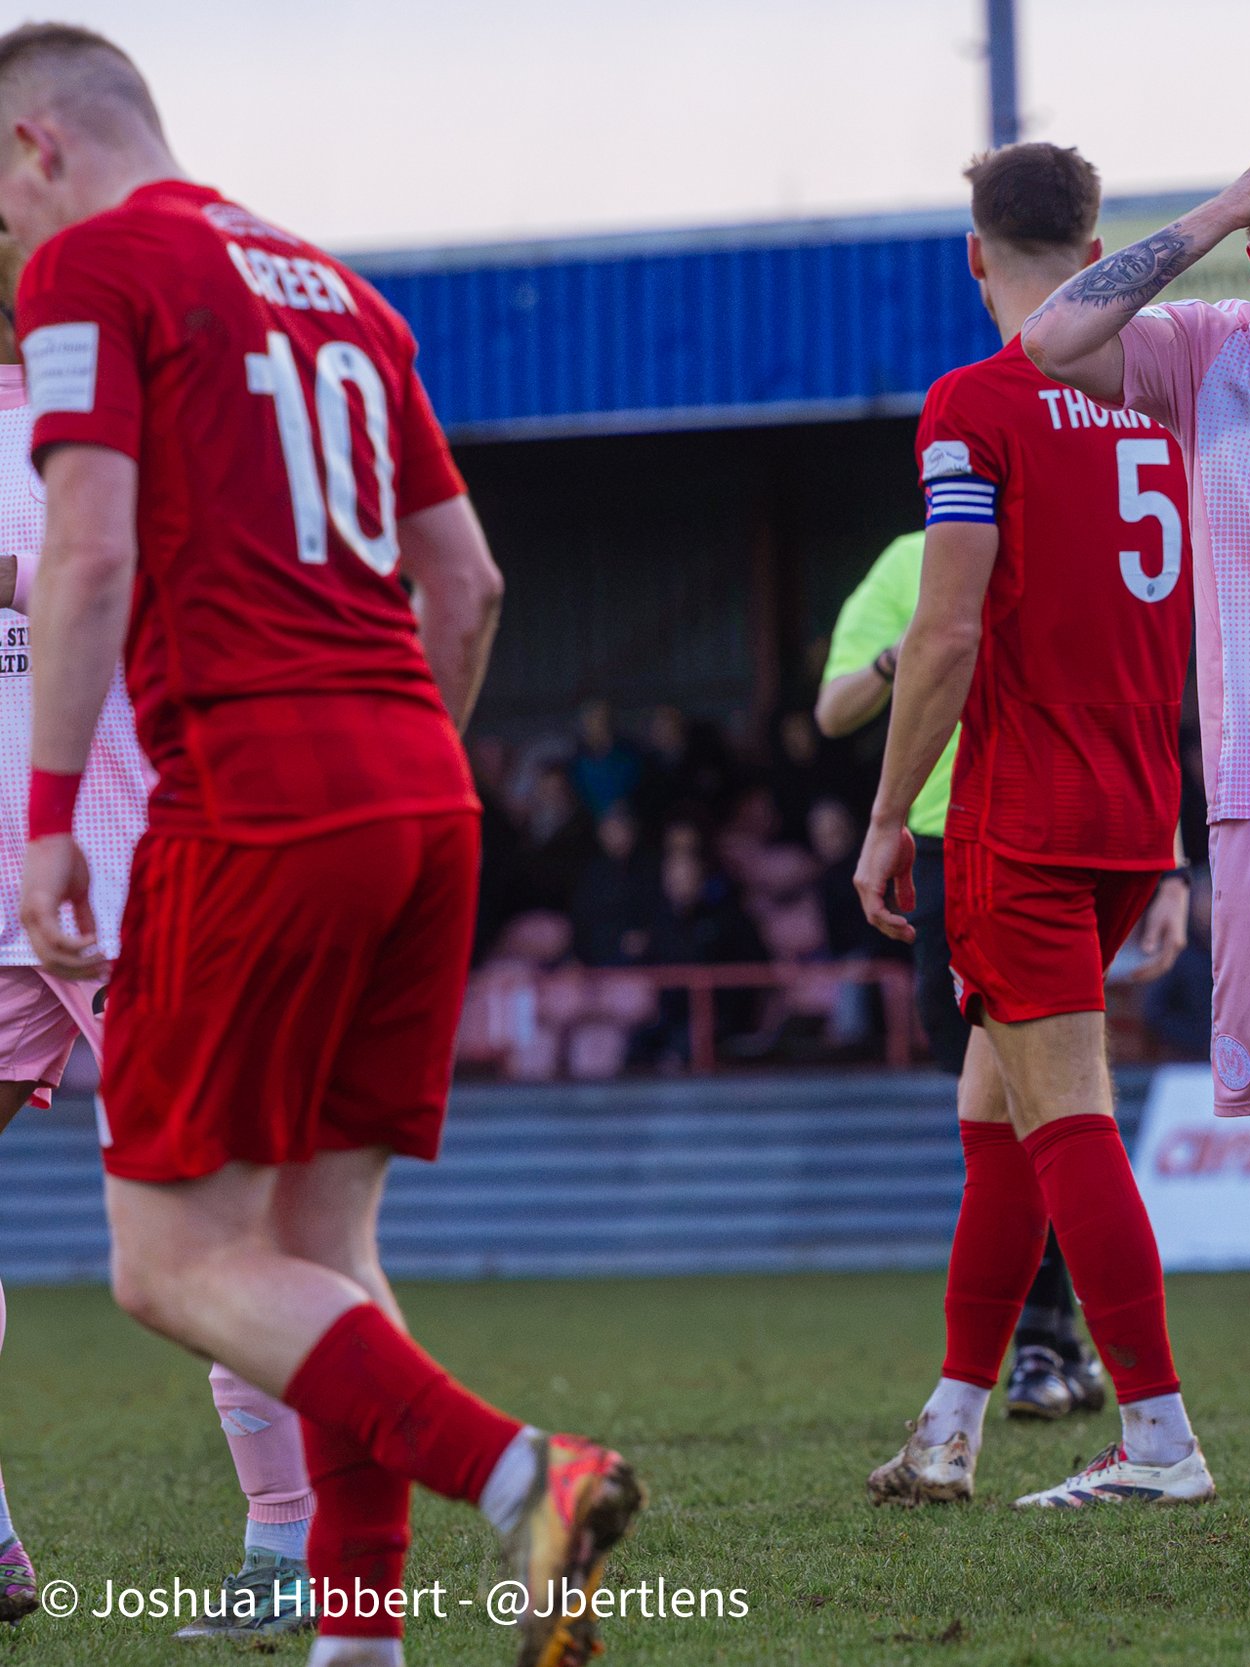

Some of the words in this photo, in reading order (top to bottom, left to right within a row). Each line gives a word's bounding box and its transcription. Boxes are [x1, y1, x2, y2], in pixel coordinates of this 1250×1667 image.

[226, 240, 359, 317] GREEN
[244, 330, 399, 577] 10
[1116, 438, 1182, 603] 5
